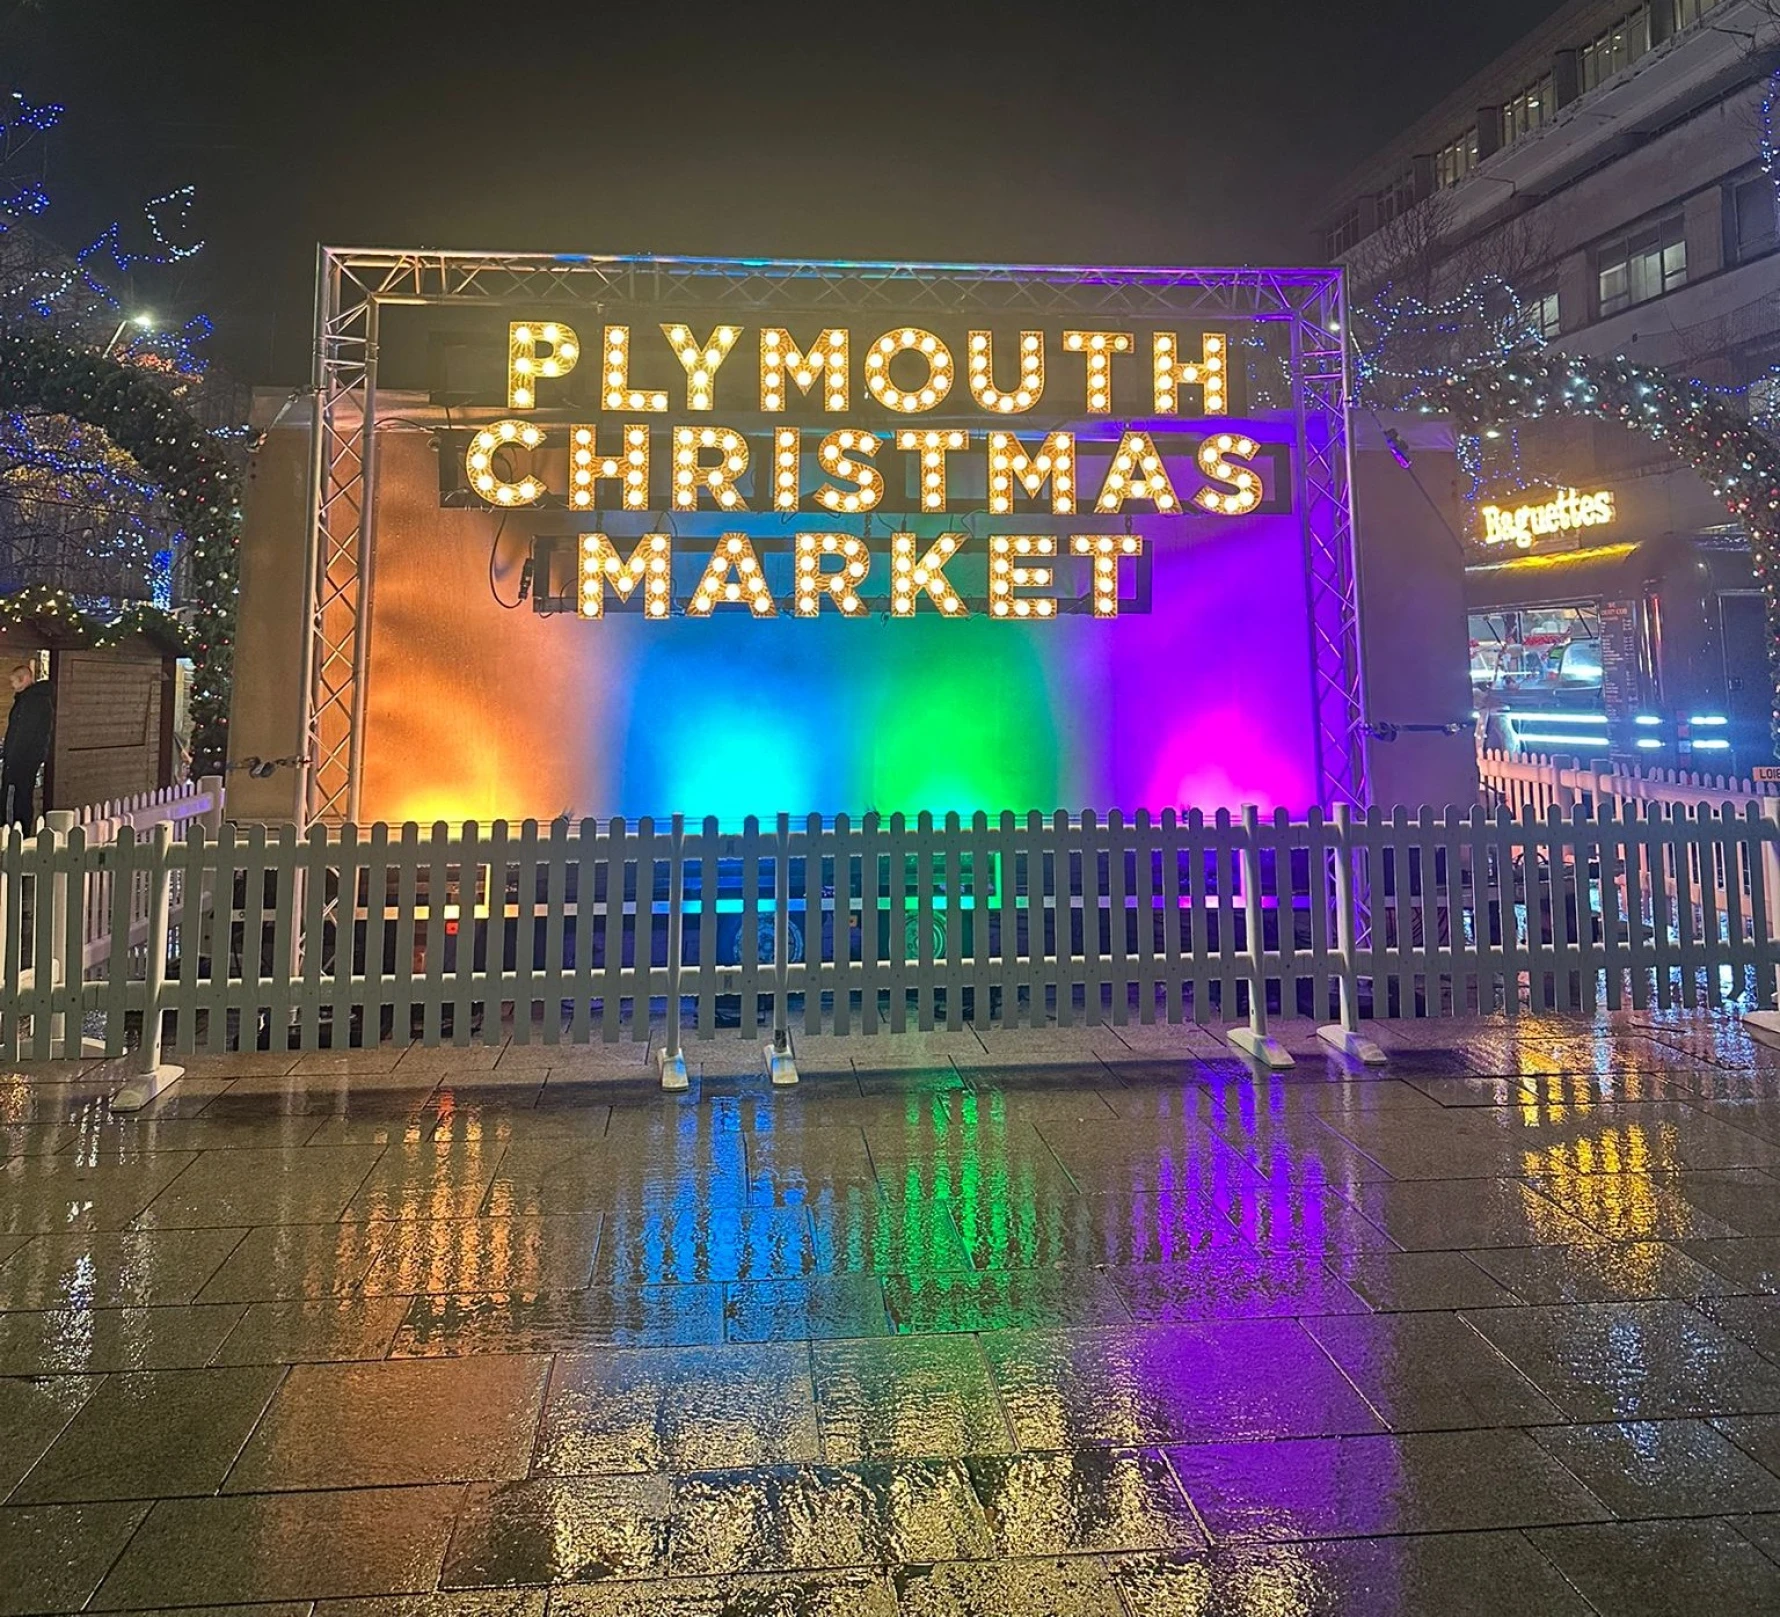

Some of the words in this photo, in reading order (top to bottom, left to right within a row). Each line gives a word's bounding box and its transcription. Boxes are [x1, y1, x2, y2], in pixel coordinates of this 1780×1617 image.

[507, 320, 1229, 416] PLYMOUTH
[465, 418, 1264, 515] CHRISTMAS
[1481, 486, 1613, 549] Baguettes
[577, 531, 1143, 620] MARKET
